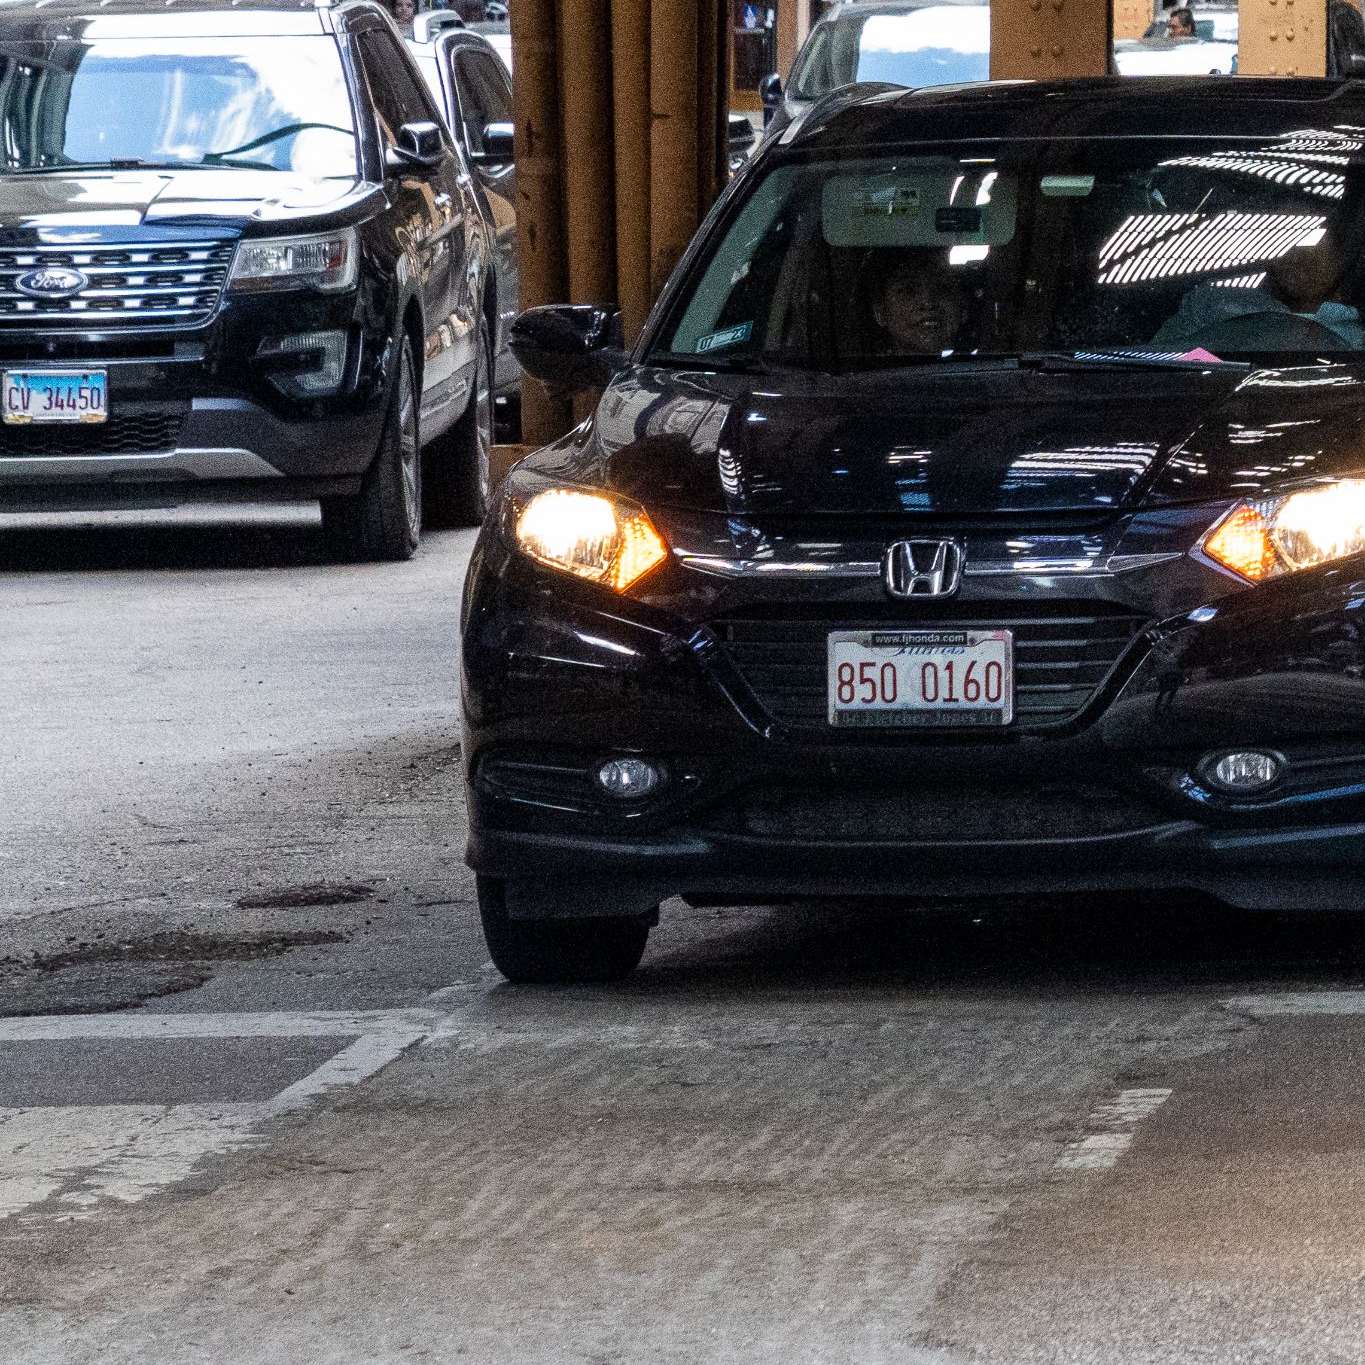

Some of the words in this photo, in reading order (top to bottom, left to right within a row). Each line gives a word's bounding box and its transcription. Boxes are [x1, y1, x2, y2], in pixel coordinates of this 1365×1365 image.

[30, 272, 80, 289] Ford
[8, 387, 31, 411] CV
[43, 386, 100, 411] 34450
[875, 633, 965, 645] www.fjhonda.com
[838, 662, 898, 704] 850
[920, 660, 1002, 703] 0160
